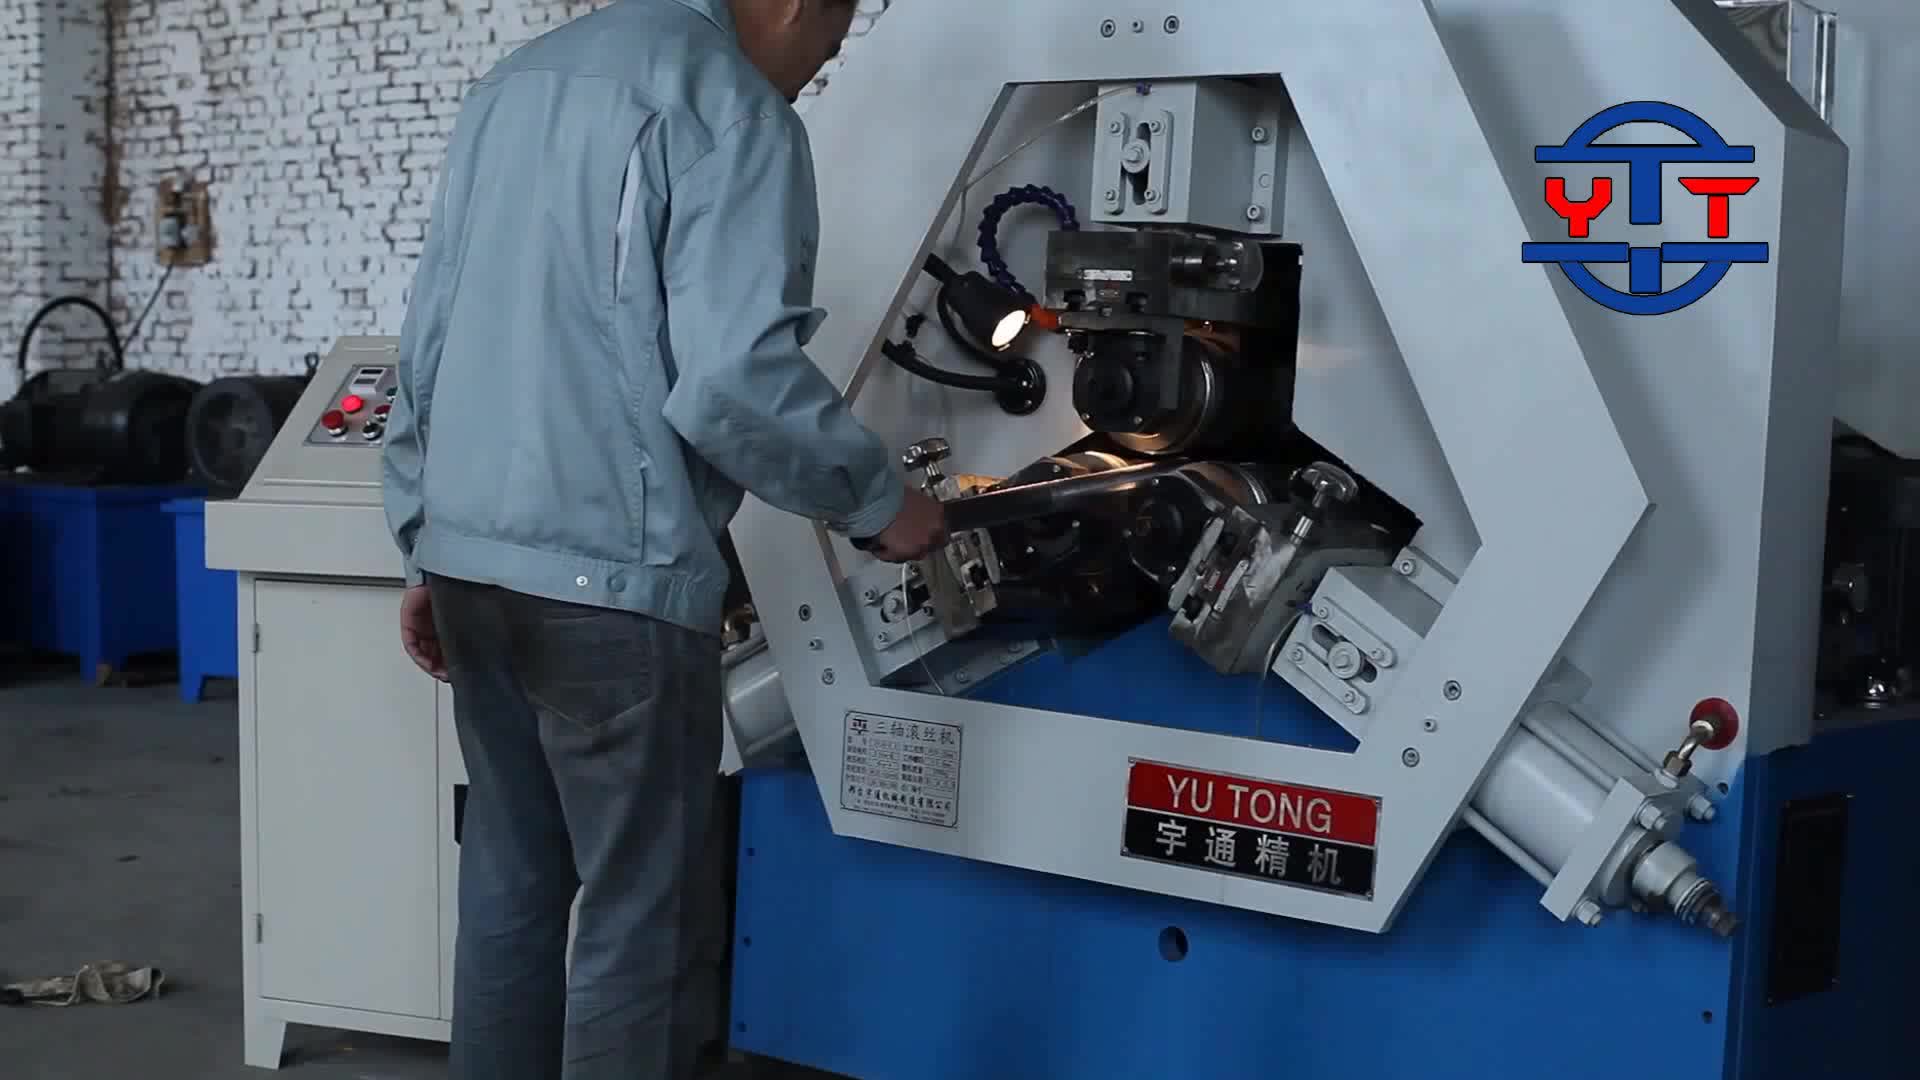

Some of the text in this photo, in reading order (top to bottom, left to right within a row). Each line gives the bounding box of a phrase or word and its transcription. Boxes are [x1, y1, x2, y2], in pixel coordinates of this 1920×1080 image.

[873, 721, 955, 745] 三轴滚丝机
[1167, 774, 1334, 834] YU TONG
[1155, 819, 1345, 887] 宇通精机
